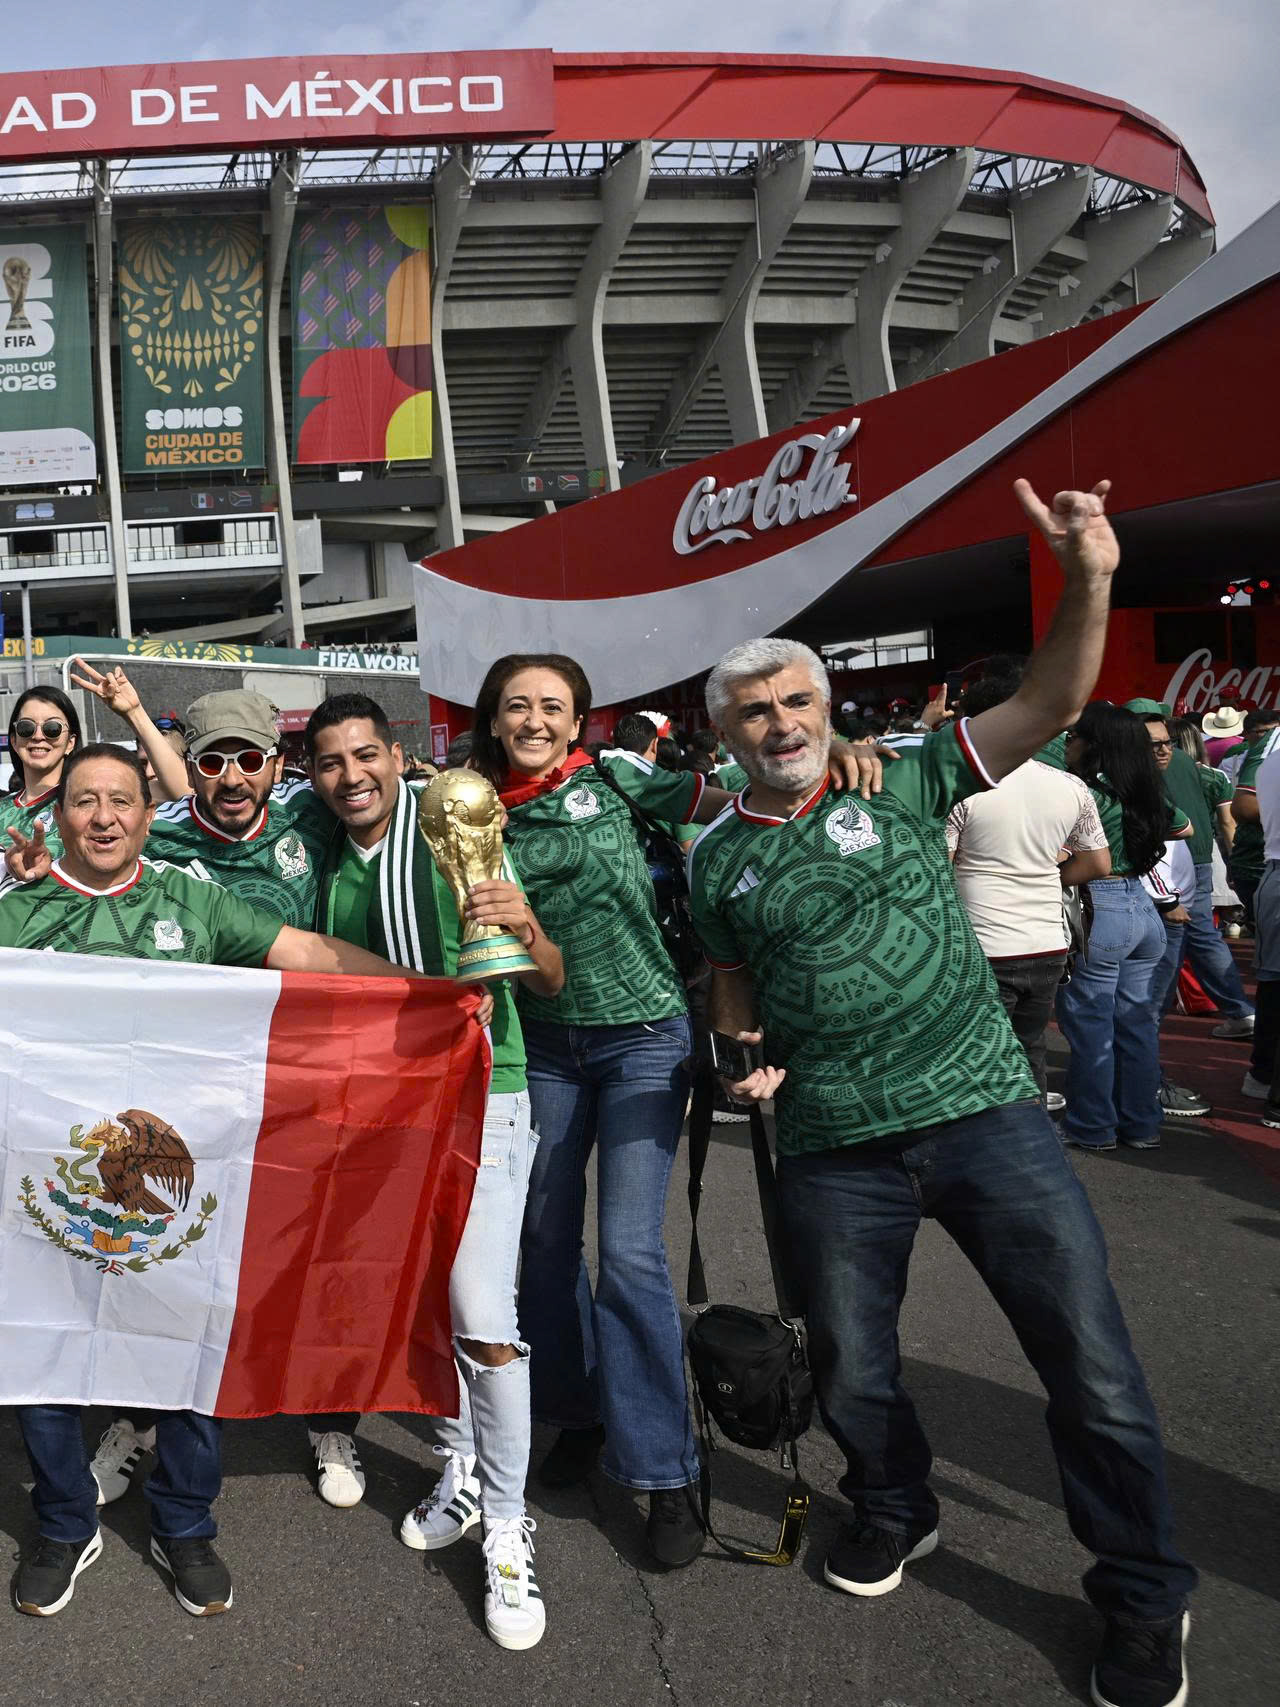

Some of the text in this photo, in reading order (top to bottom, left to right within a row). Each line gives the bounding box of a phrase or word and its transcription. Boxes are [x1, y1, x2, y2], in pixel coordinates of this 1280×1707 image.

[131, 85, 220, 126] DE
[245, 71, 504, 120] MÉXICO
[4, 335, 36, 348] FIFA
[31, 361, 56, 372] CUP
[145, 406, 243, 430] SOMOS
[145, 432, 243, 449] CIUDAD DE
[145, 447, 243, 466] MÉXICO
[673, 418, 861, 555] Coca-Cola
[3, 638, 45, 656] EXIO
[319, 651, 420, 671] FIFA WORL
[841, 836, 879, 854] MEXICO
[282, 865, 308, 878] MEXICO
